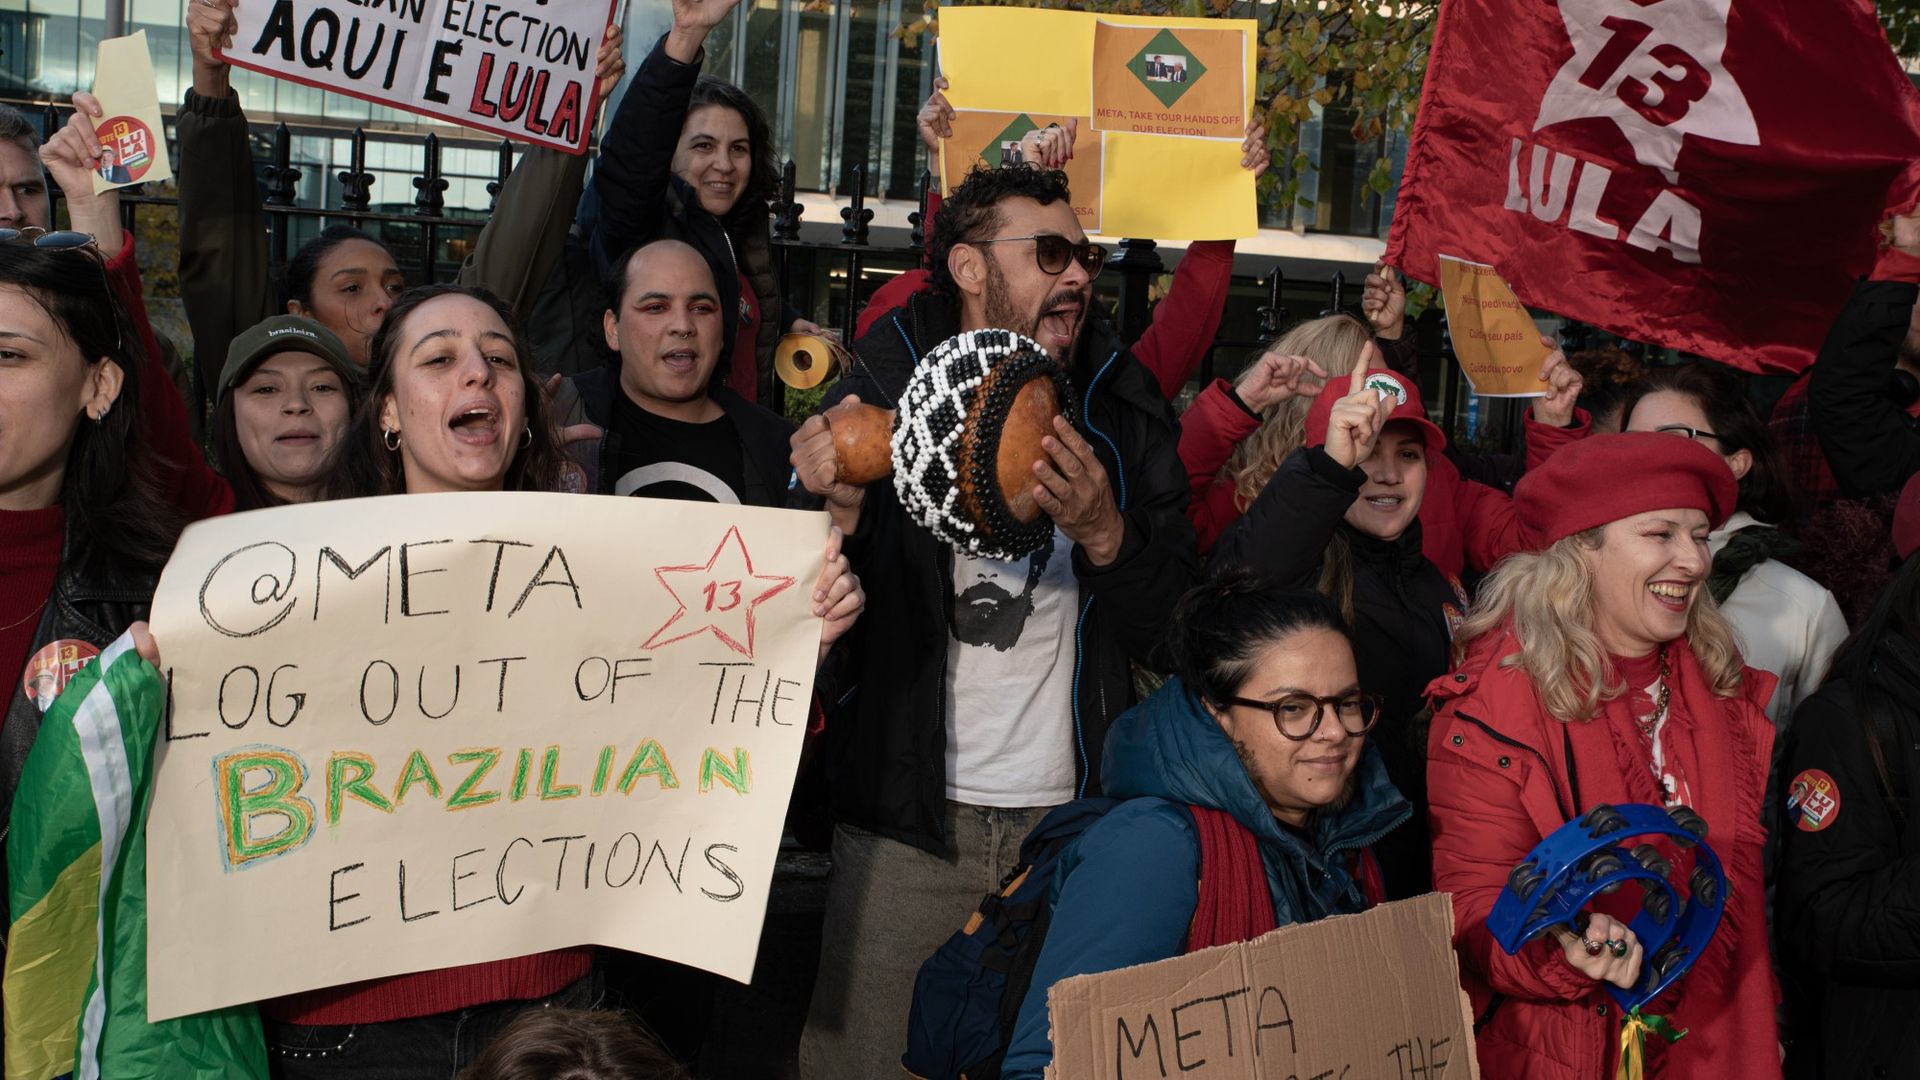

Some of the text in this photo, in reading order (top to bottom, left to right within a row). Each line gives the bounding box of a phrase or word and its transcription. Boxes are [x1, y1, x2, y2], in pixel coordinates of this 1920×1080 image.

[443, 0, 591, 71] ELECTION
[252, 0, 407, 90] AQUI
[469, 52, 582, 144] LULA
[1578, 15, 1712, 127] 13
[116, 124, 125, 135] 13
[120, 131, 141, 145] LU
[1097, 108, 1241, 125] META, TAKE YOUR HANDS OFF
[1132, 124, 1207, 136] OUR ELECTION!
[1072, 206, 1095, 216] SSA
[1504, 137, 1702, 264] LULA
[703, 580, 743, 613] 13
[61, 646, 73, 660] 13
[165, 656, 800, 741] LOG OUT OF THE
[213, 738, 751, 873] BRAZILIAN
[1811, 790, 1832, 808] LU
[329, 832, 744, 932] ELECTIONS
[1117, 986, 1297, 1080] META
